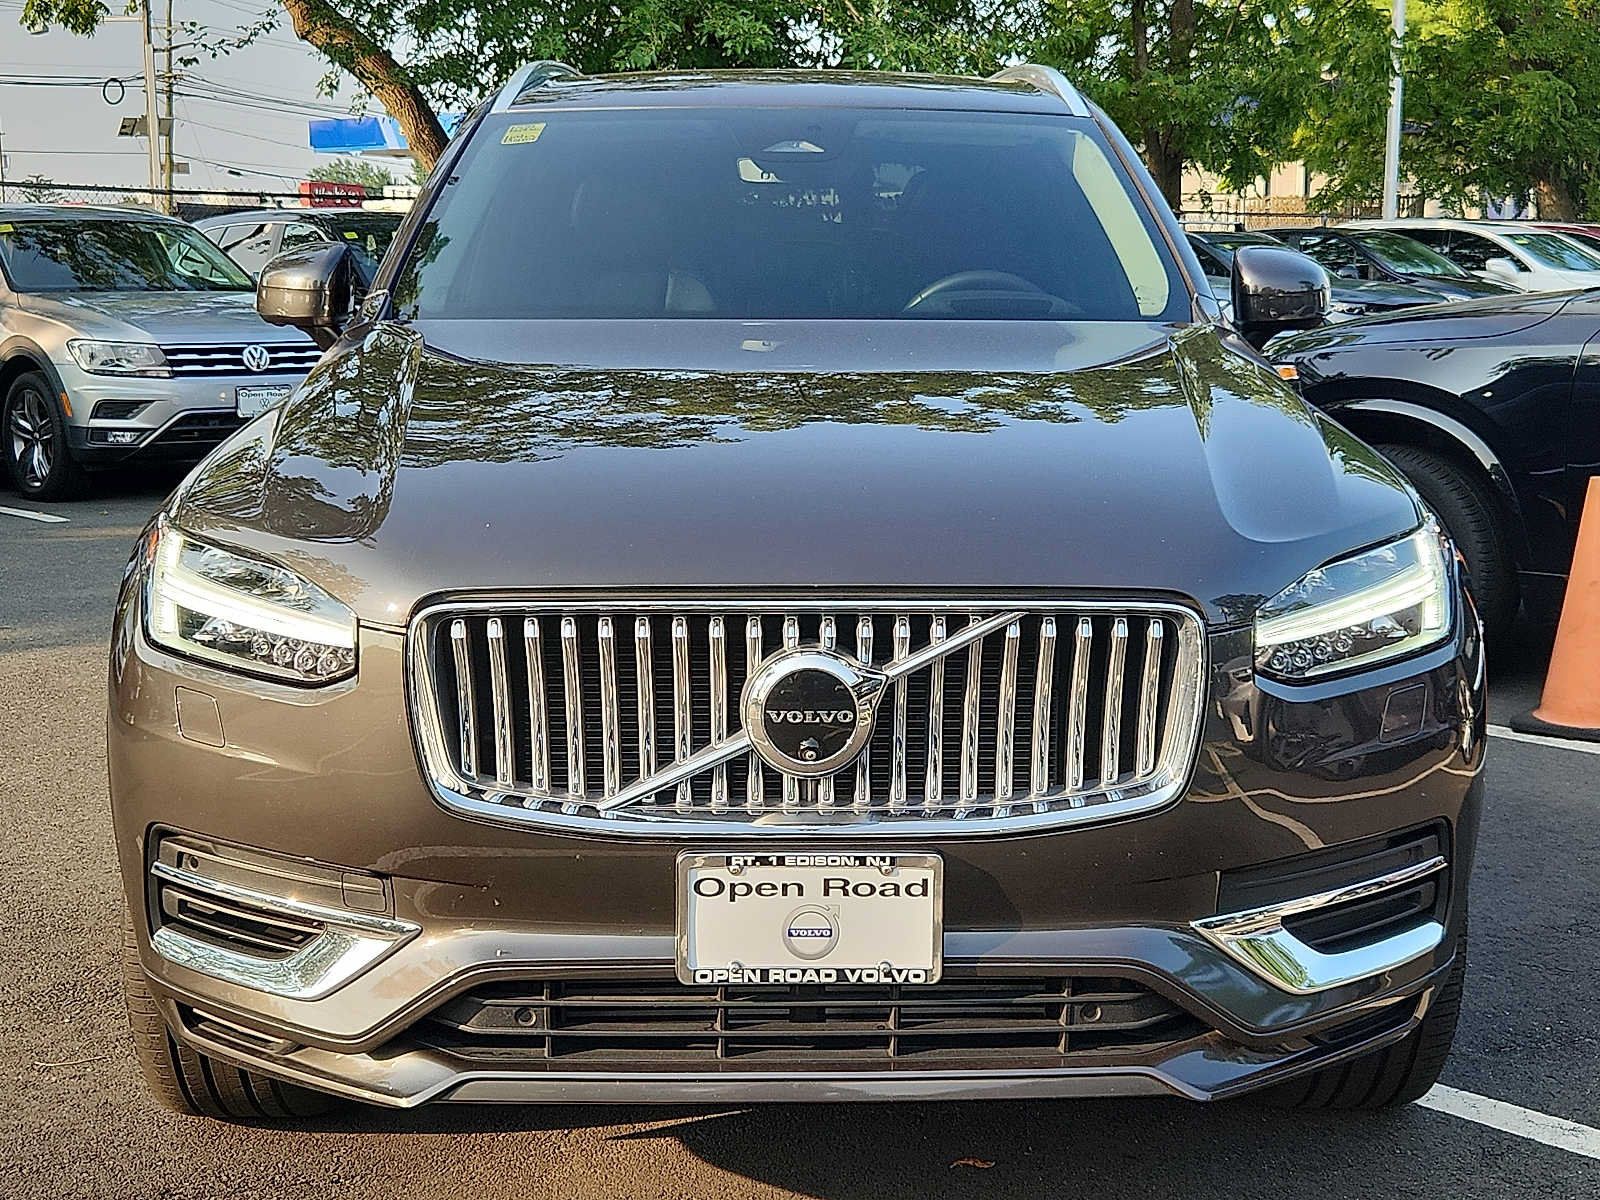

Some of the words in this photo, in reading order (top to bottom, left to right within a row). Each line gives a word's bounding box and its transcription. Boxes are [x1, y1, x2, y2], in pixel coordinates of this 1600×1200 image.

[241, 391, 264, 399] Open
[766, 710, 854, 723] VOLVO
[731, 856, 761, 866] RT.
[767, 856, 778, 866] 1
[784, 856, 860, 867] EDISON,
[865, 856, 891, 866] NJ
[693, 877, 805, 902] Open
[822, 877, 928, 898] Road
[790, 929, 831, 937] VOLVO
[694, 969, 761, 983] OPEN
[768, 969, 837, 983] ROAD
[843, 969, 927, 983] VOLVO
